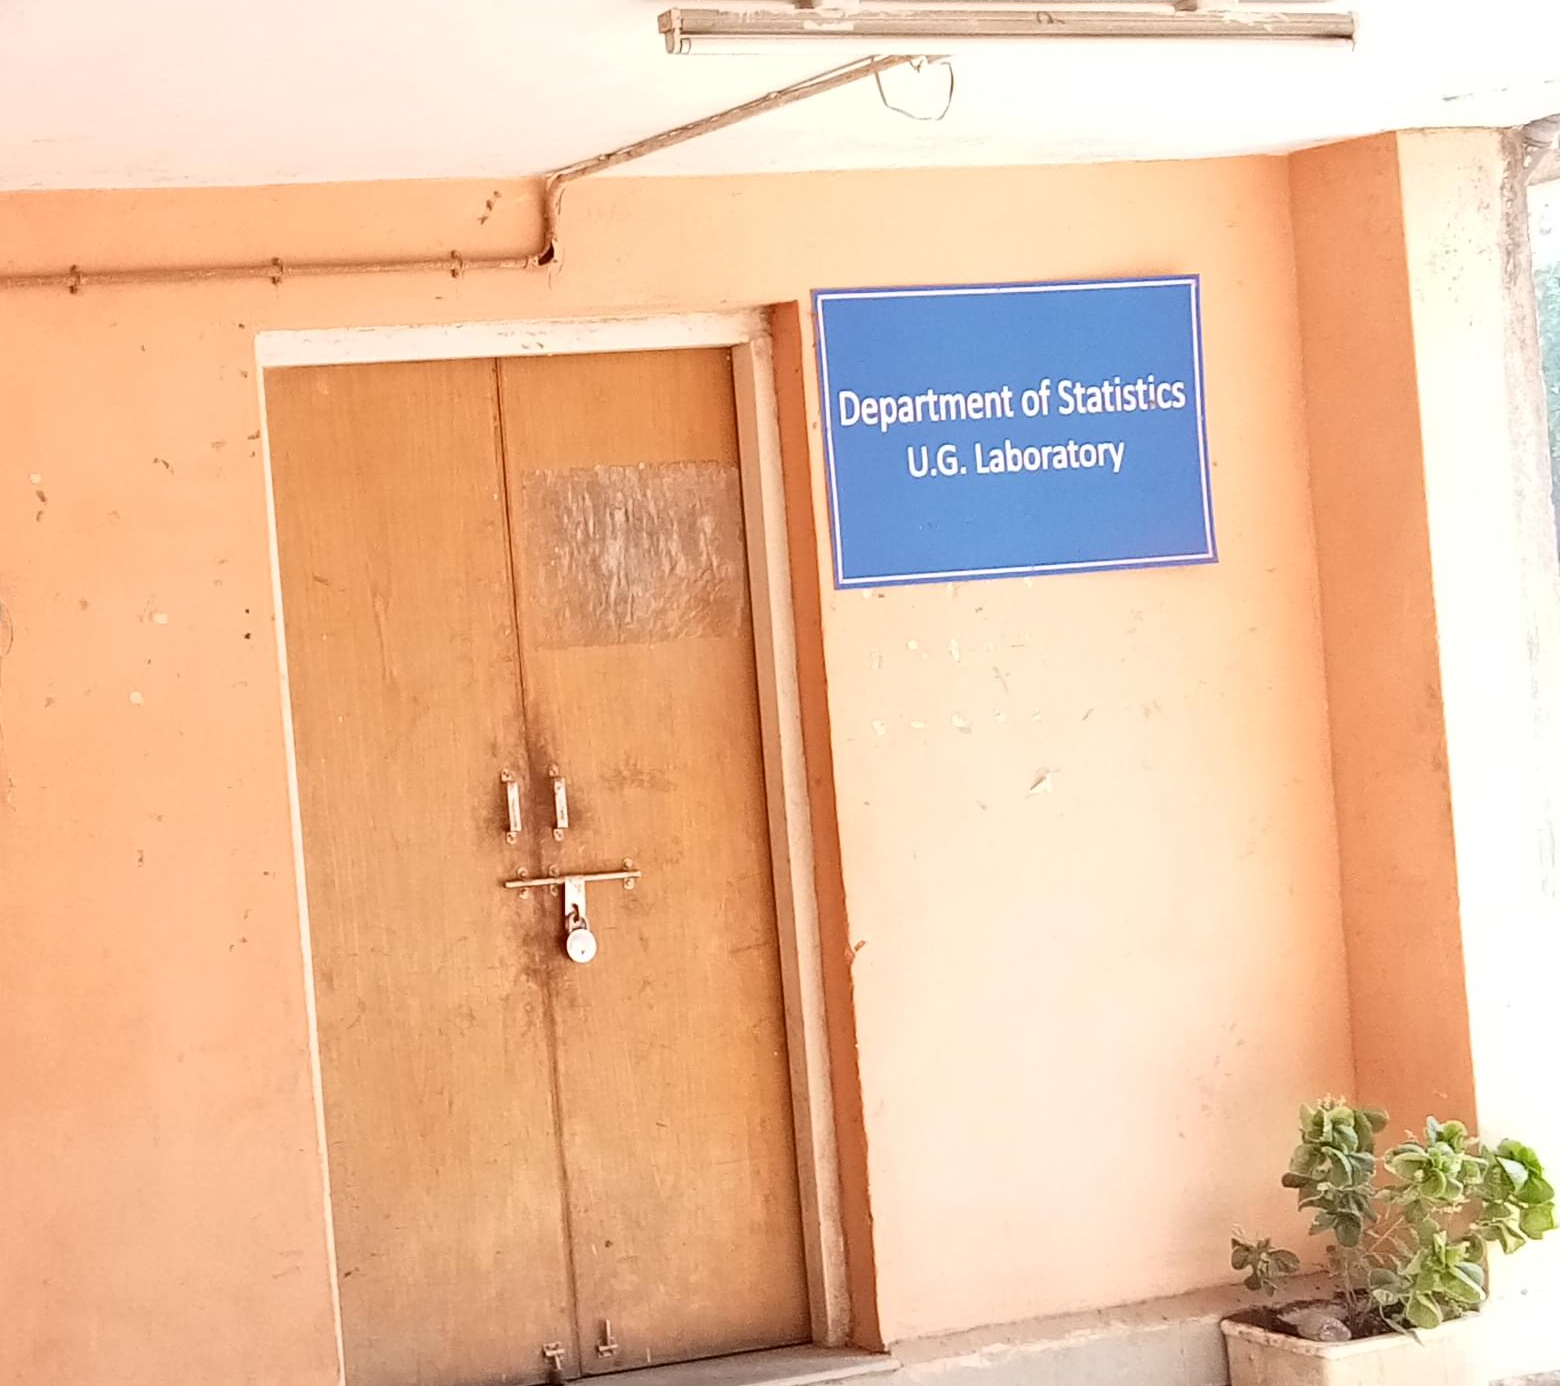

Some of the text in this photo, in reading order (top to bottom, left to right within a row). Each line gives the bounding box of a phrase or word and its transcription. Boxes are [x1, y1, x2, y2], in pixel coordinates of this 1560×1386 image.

[839, 374, 1187, 432] Department of Statistics
[906, 439, 1126, 478] U.G. Laboratory
